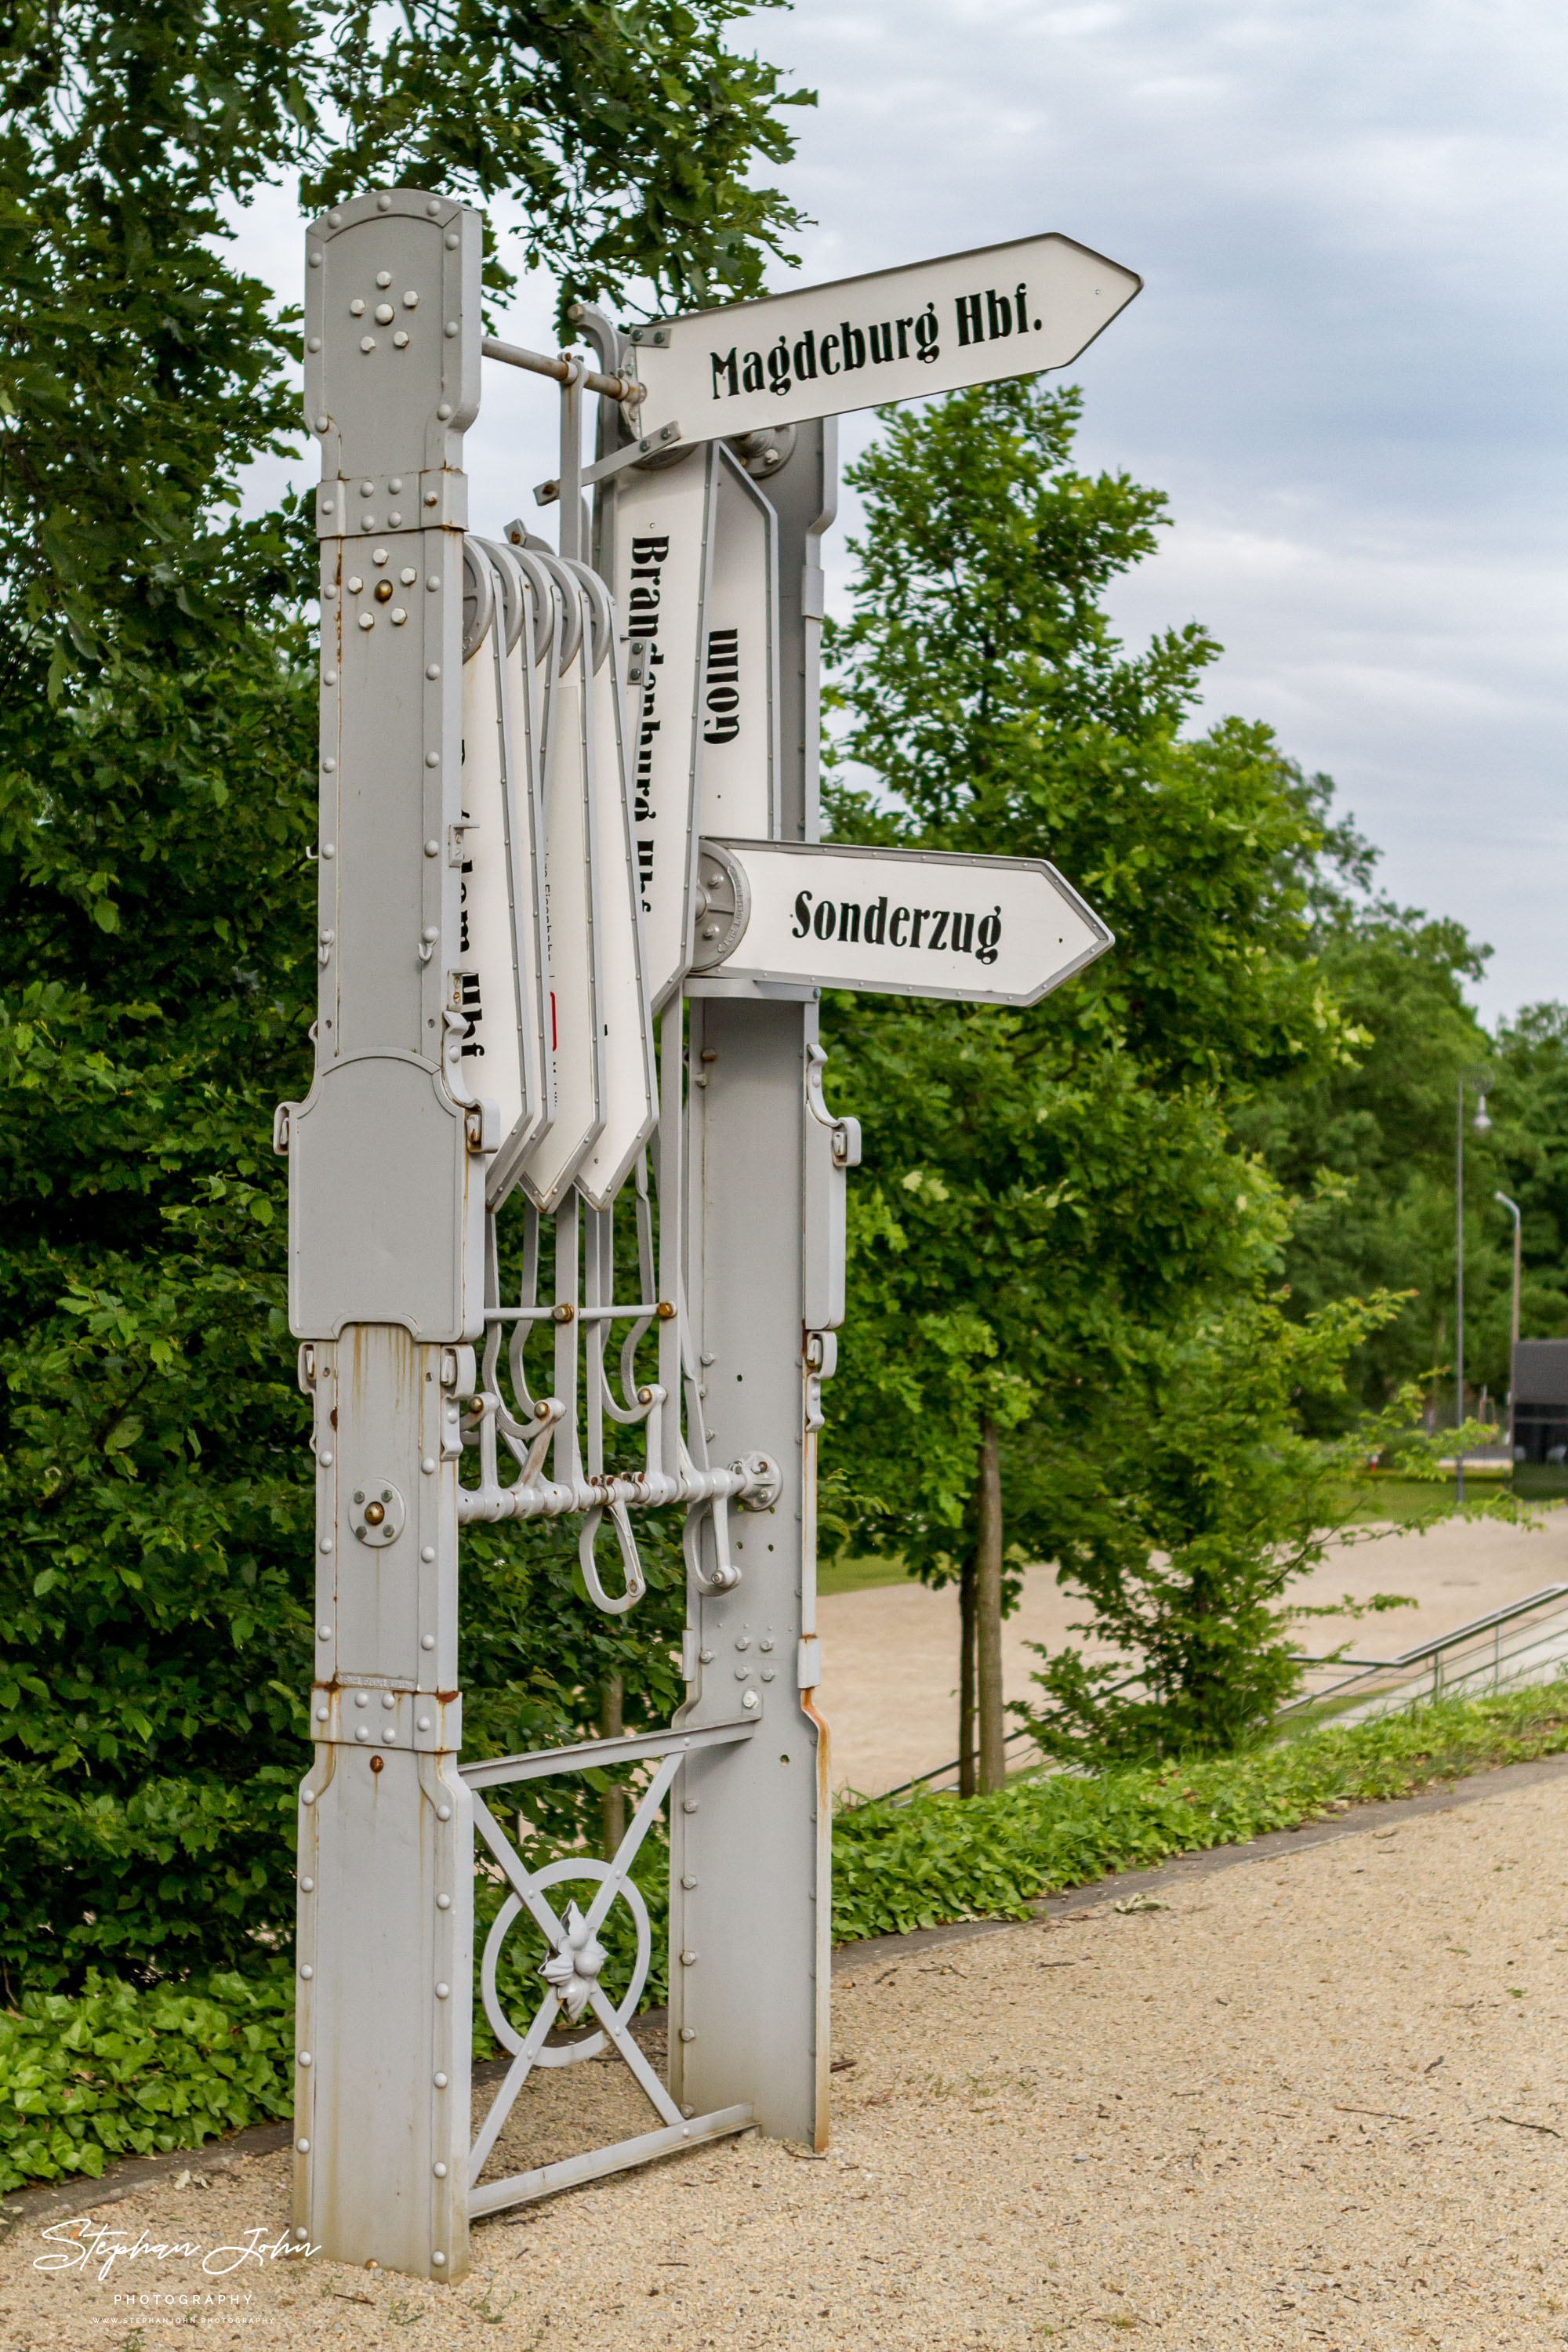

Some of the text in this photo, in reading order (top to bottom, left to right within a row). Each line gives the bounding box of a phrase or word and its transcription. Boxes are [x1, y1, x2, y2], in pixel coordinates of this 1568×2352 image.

[710, 282, 1042, 400] Magdeburg Hbf.
[791, 890, 1001, 965] Sonderzug
